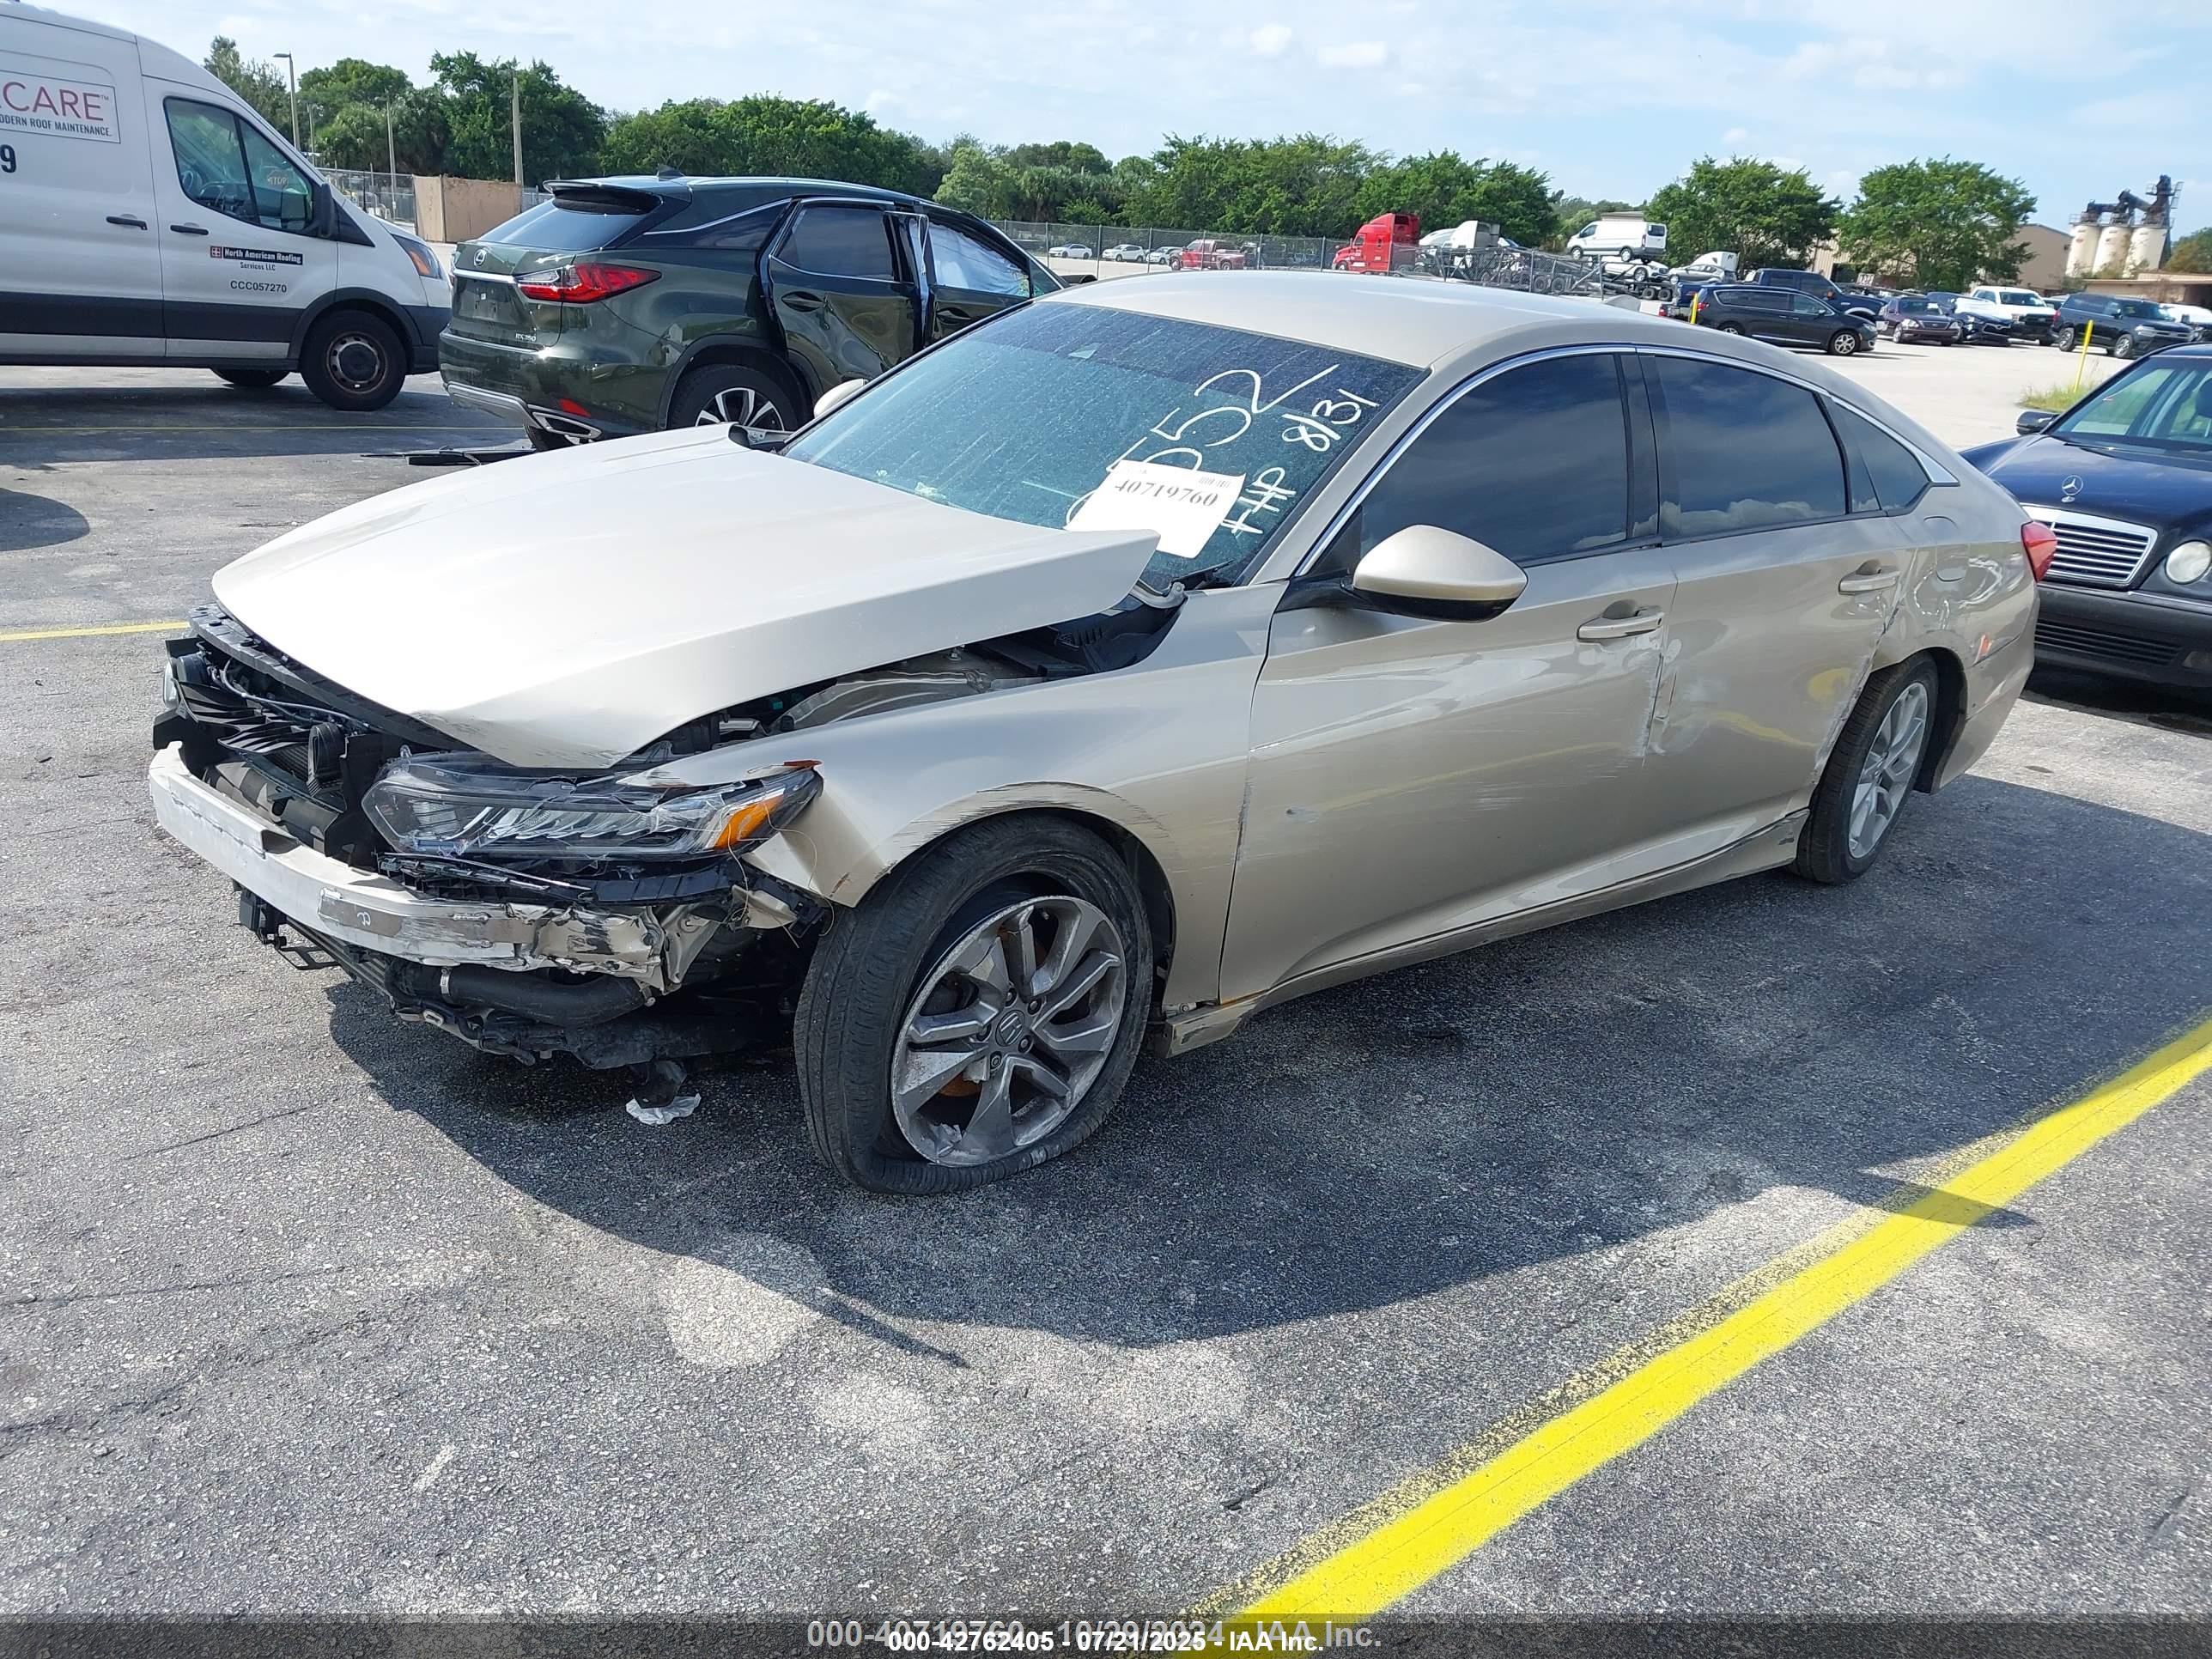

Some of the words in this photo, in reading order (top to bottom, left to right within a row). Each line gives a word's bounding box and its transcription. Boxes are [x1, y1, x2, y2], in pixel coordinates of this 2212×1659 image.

[30, 118, 52, 130] ROOF
[224, 248, 243, 258] North
[245, 250, 276, 260] American
[276, 253, 301, 264] Roofing
[240, 261, 264, 270] Services
[230, 280, 287, 293] CCC057270
[1281, 388, 1380, 452] 8/31
[1115, 478, 1218, 507] 40719760
